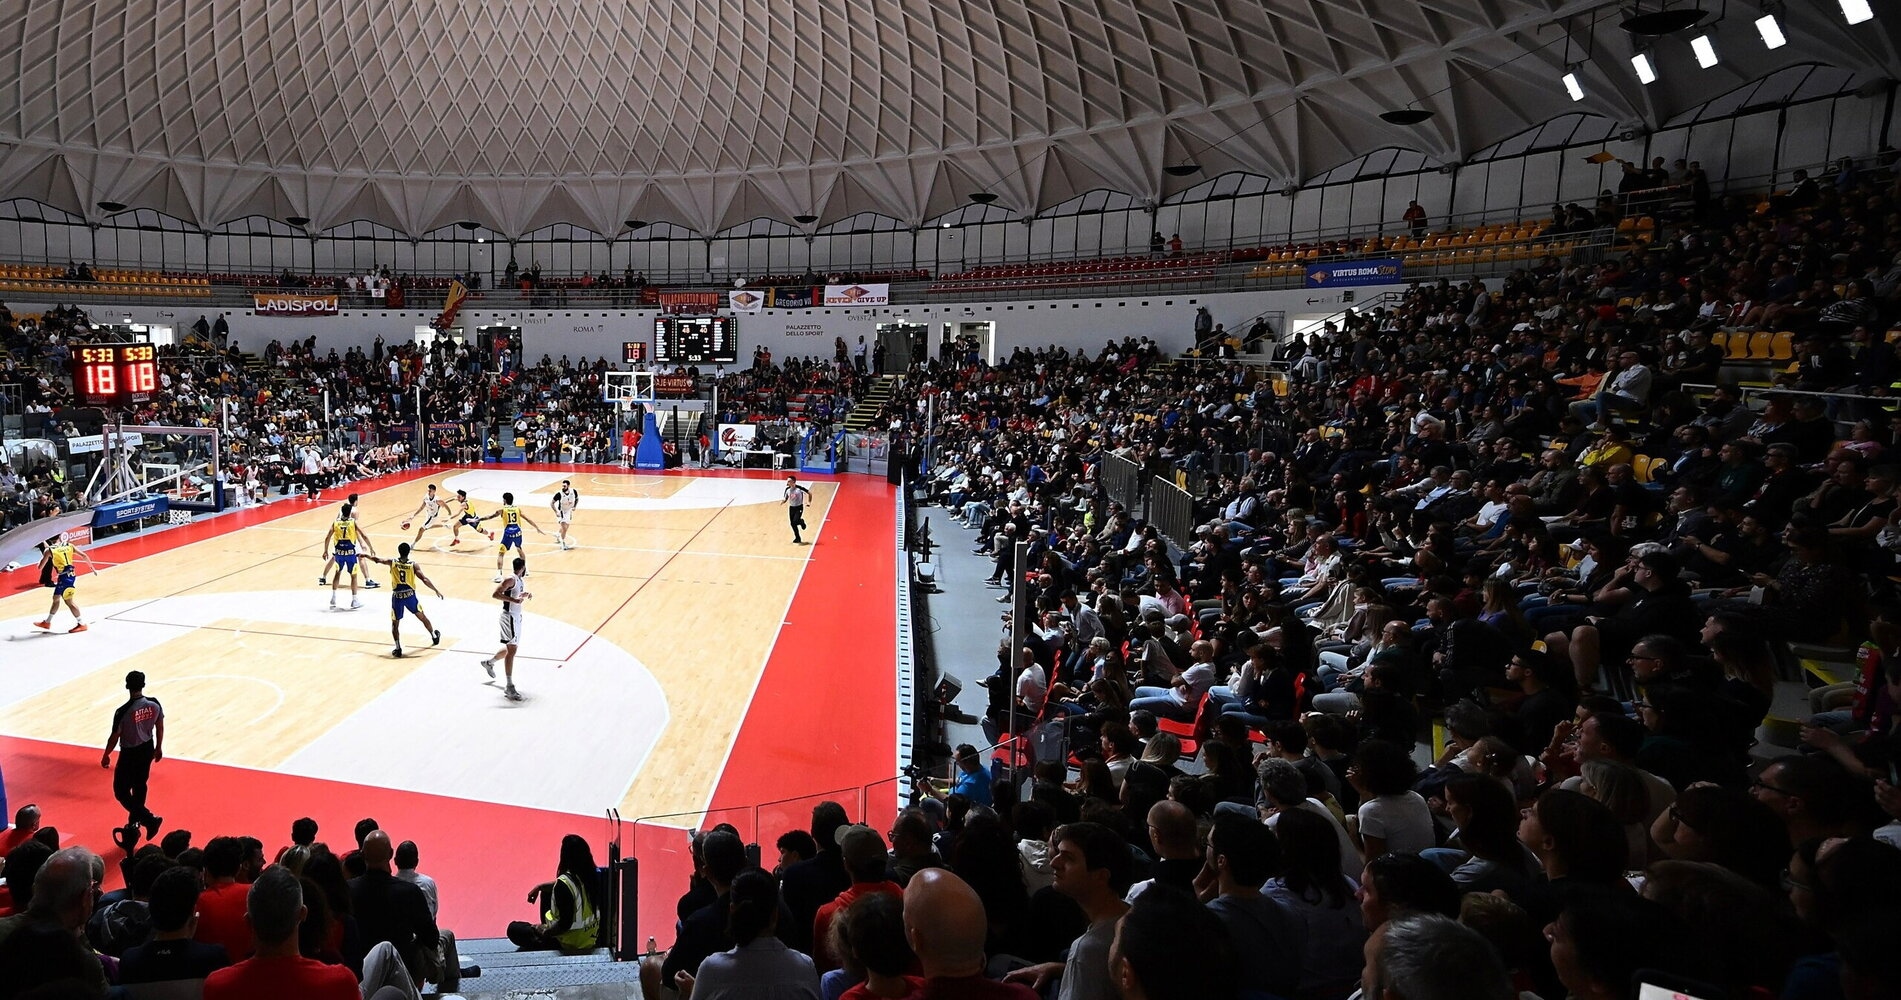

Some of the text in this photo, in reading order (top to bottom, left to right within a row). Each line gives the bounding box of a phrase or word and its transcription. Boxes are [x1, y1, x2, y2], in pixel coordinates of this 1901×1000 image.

[1332, 268, 1357, 277] VIRTUS
[1358, 267, 1378, 276] ROMA
[255, 299, 338, 312] LADISPOLI
[776, 298, 803, 307] GREGORIO
[82, 348, 114, 362] 5:33
[126, 346, 152, 361] 5:33
[628, 349, 640, 359] 18
[86, 365, 116, 394] 18
[130, 362, 155, 392] 18
[508, 512, 517, 523] 13
[340, 527, 347, 538] 7
[64, 552, 68, 564] 1
[400, 570, 406, 582] 8
